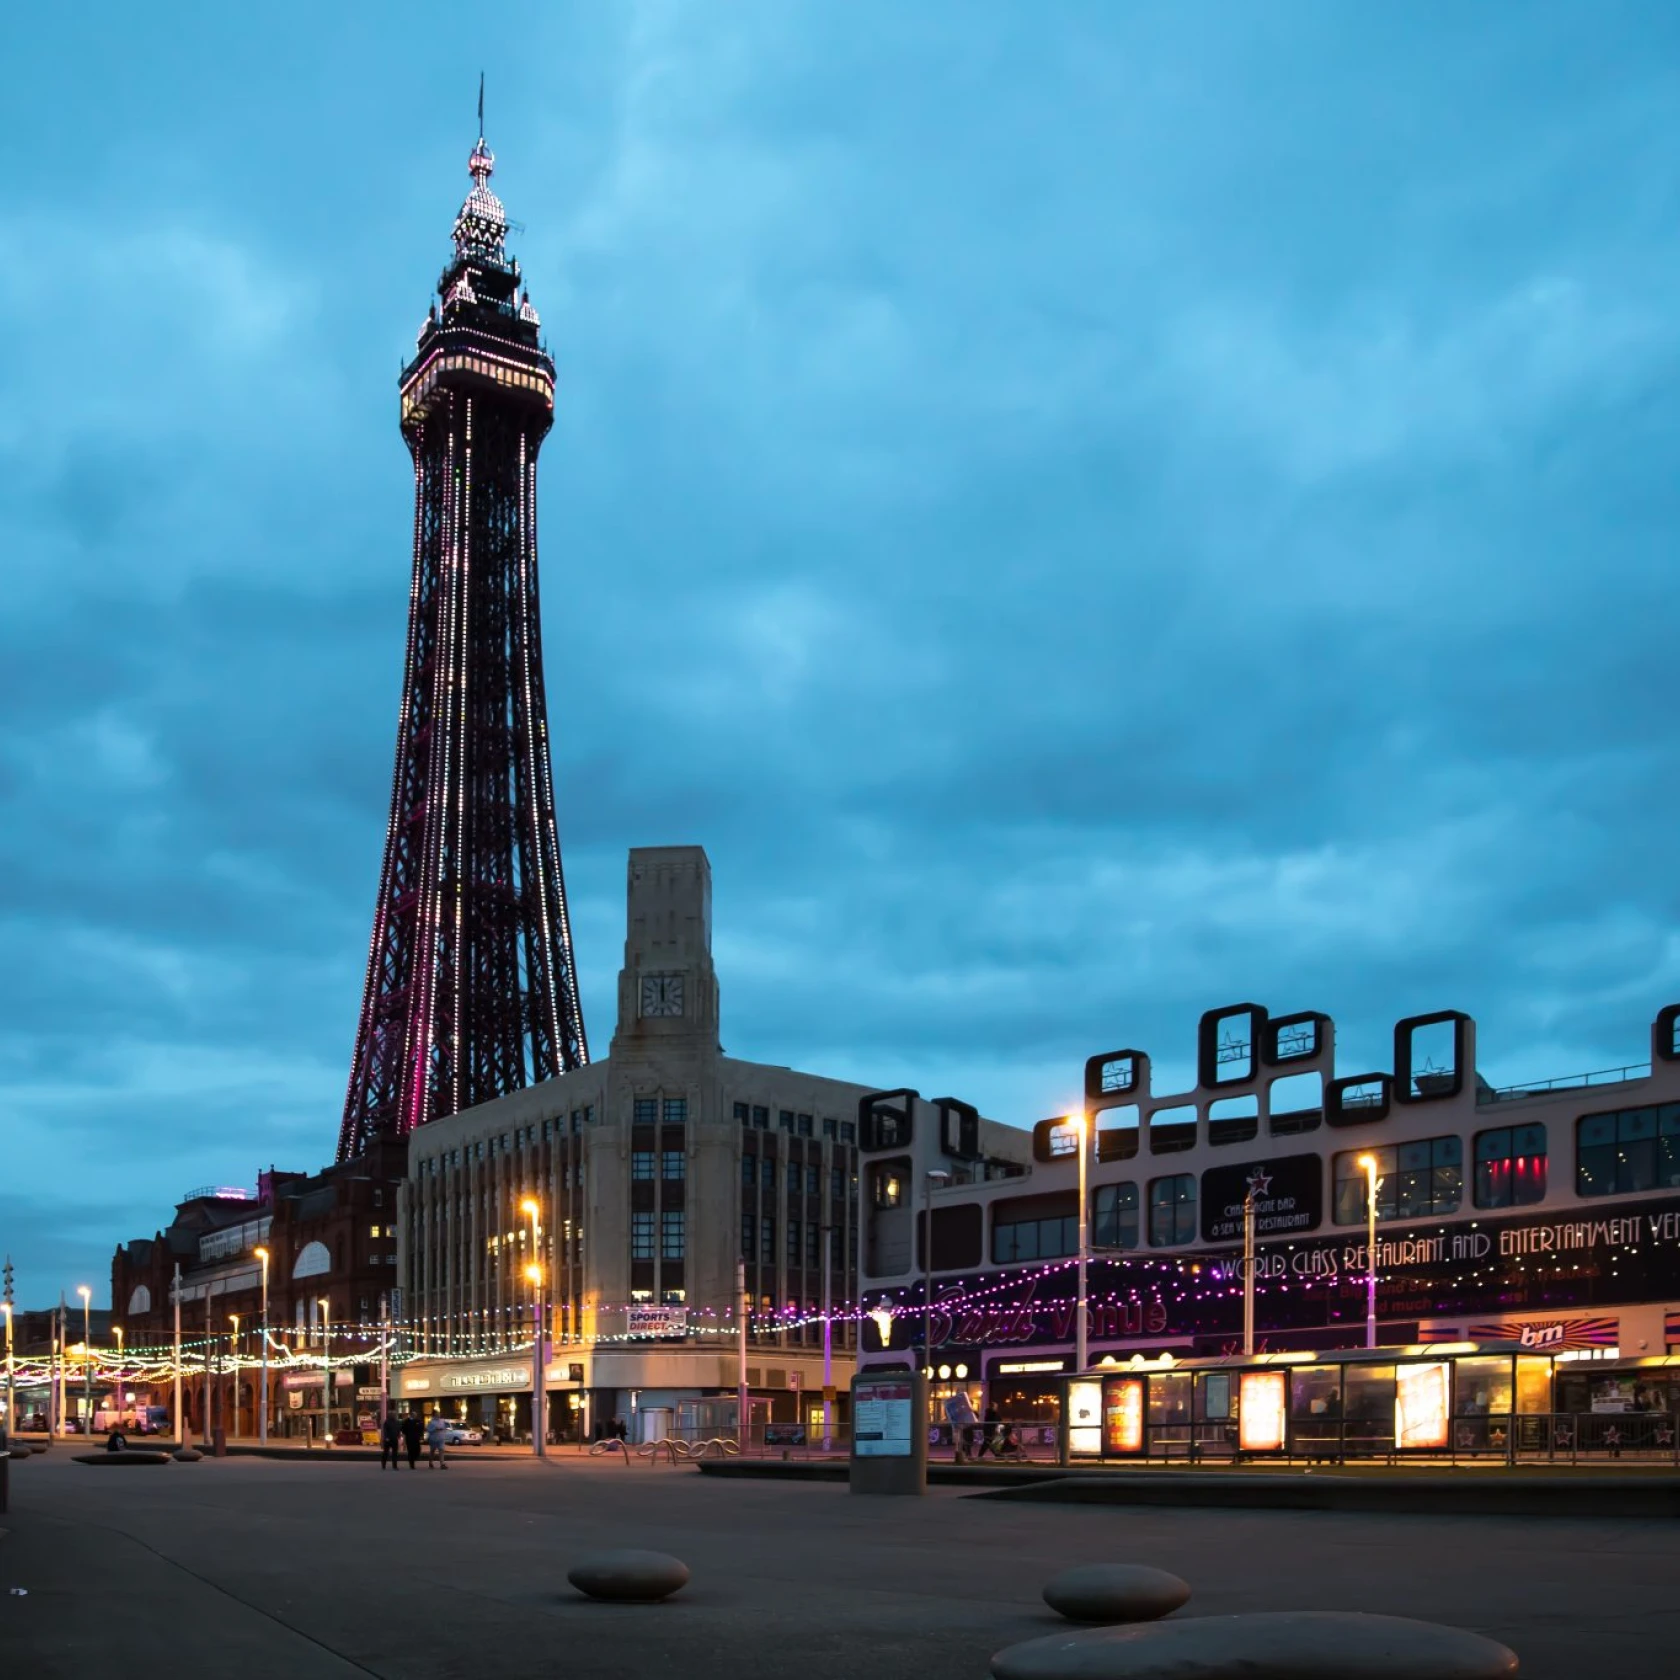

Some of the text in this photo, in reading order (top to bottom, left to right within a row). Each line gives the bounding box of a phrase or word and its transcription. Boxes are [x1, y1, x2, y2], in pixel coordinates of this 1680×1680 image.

[1277, 1197, 1296, 1211] BAR
[1259, 1213, 1310, 1230] RESTAURANT
[1292, 1248, 1337, 1277] CLASS
[1452, 1233, 1491, 1259] AND
[1500, 1216, 1641, 1256] ENTERTAINMENT
[629, 1312, 670, 1322] SPORTS
